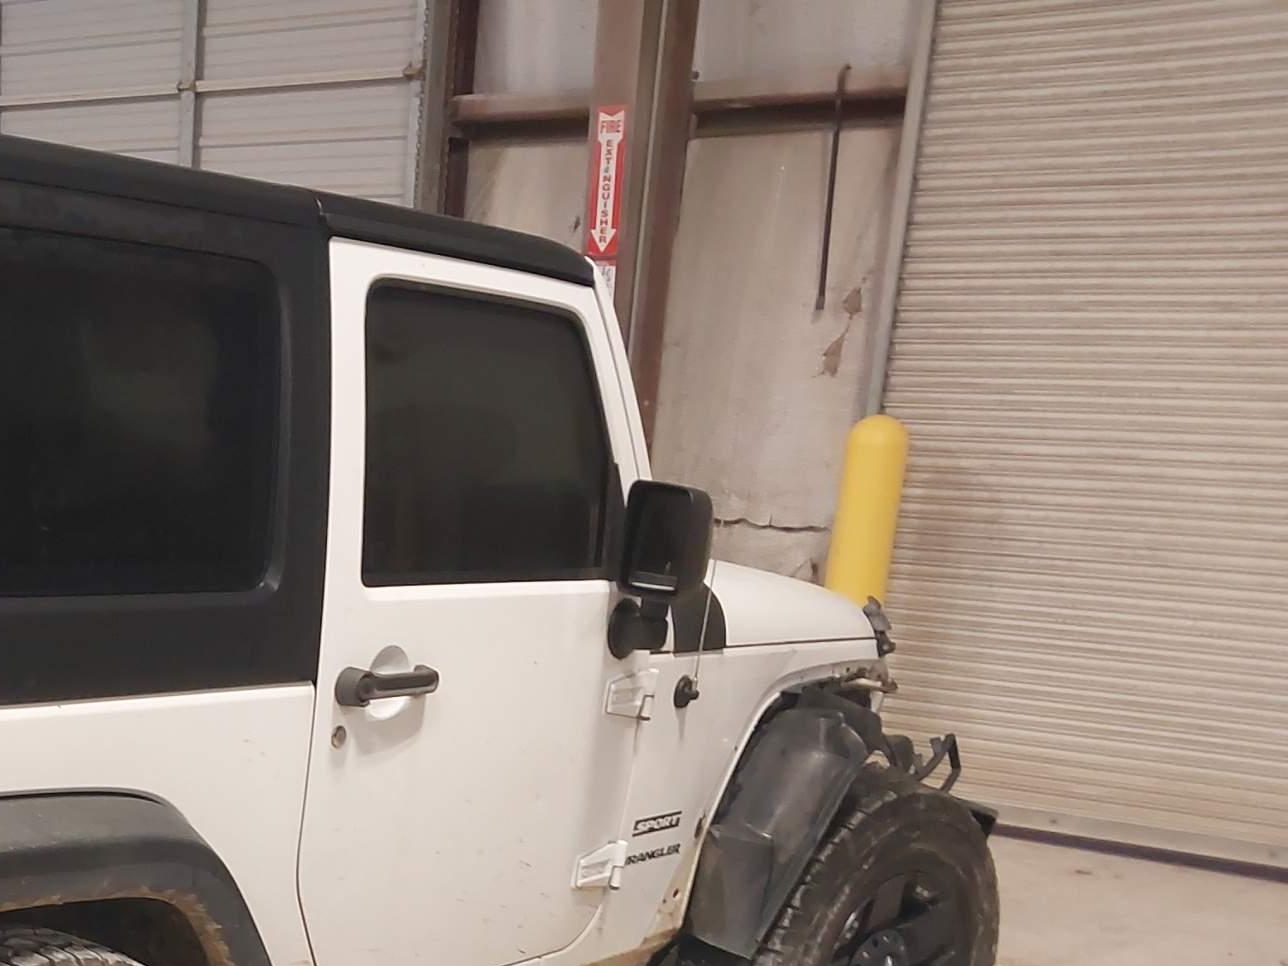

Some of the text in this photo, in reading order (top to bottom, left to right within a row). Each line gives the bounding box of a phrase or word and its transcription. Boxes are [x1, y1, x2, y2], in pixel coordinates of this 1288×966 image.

[600, 119, 622, 134] FIRE
[599, 139, 614, 243] EXTINGUISHER
[633, 812, 681, 835] SPORT
